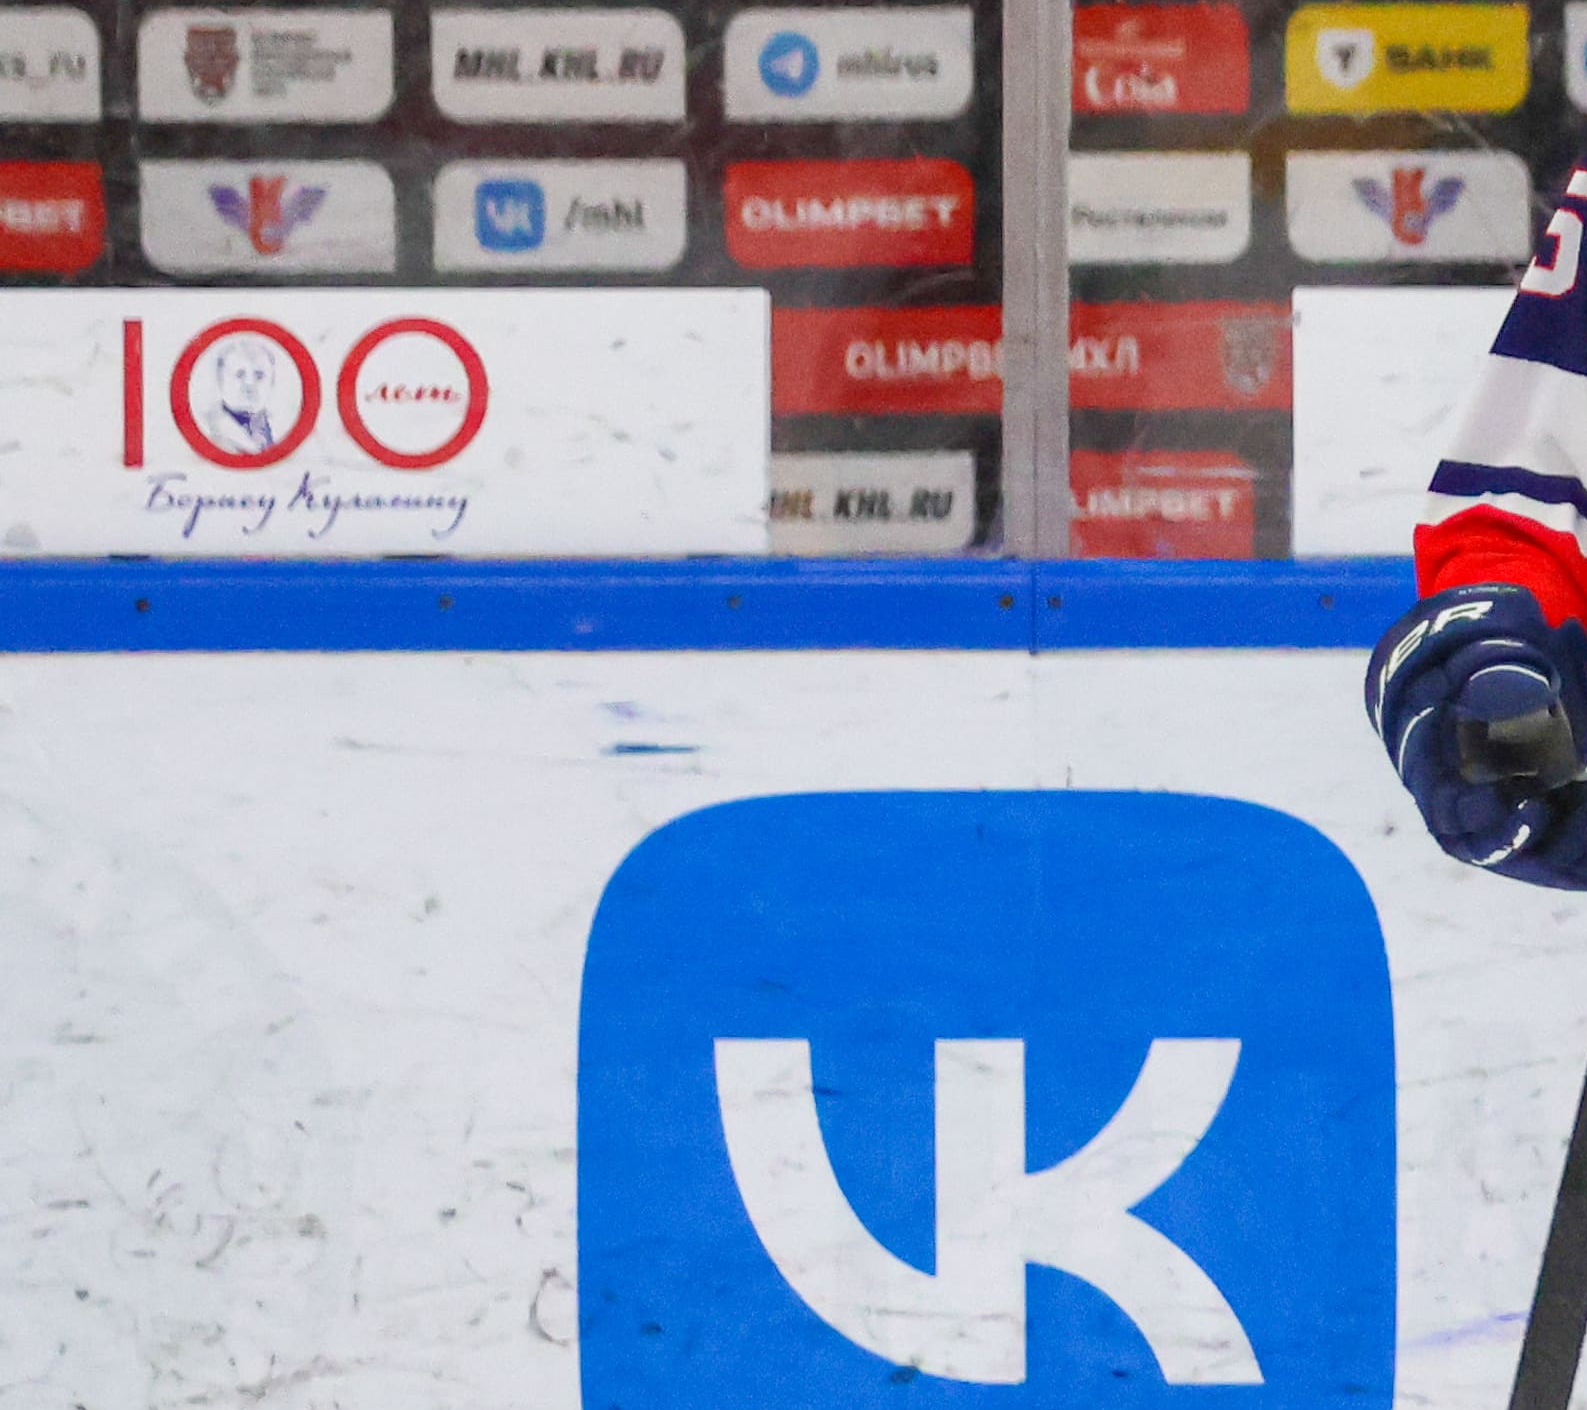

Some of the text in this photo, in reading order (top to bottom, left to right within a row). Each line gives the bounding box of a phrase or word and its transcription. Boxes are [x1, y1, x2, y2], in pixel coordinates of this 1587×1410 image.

[741, 193, 961, 232] OLIMPBET
[122, 315, 489, 469] 100
[143, 471, 277, 539] Борису
[1072, 489, 1239, 522] IMPBET
[712, 1037, 1266, 1386] VK
